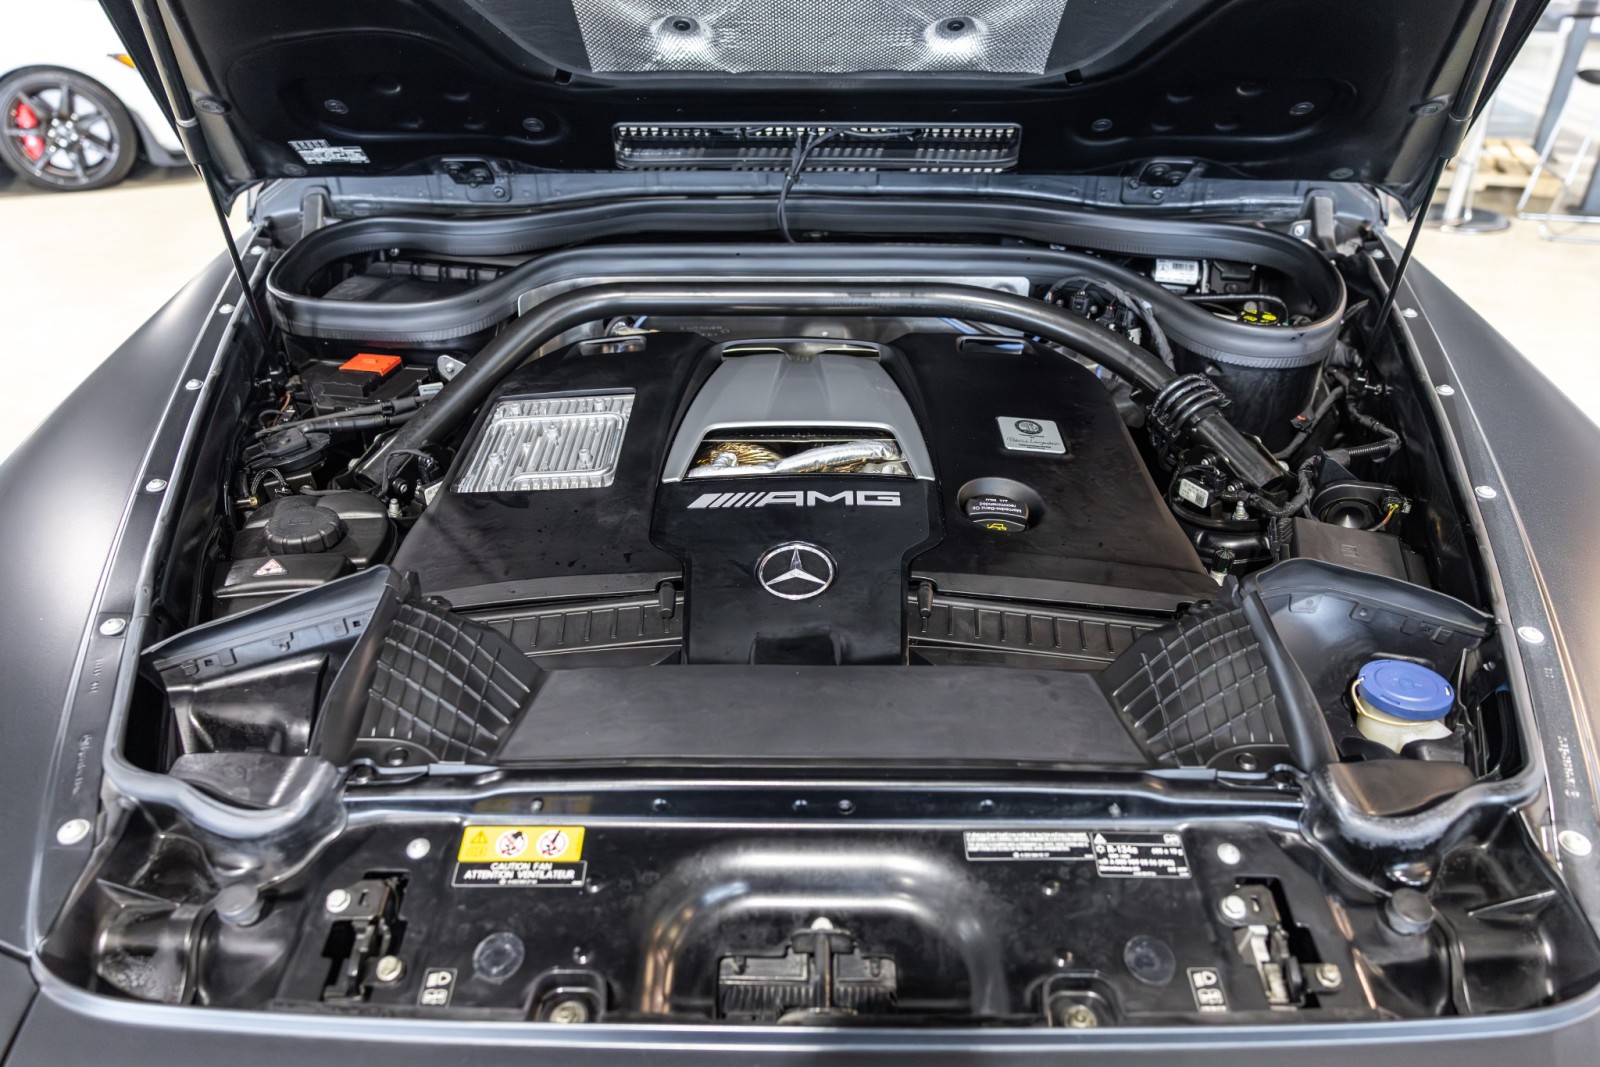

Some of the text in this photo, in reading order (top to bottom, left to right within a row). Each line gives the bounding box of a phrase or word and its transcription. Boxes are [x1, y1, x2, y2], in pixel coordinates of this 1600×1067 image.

[755, 490, 901, 507] AMG
[490, 862, 553, 871] CAUTION FAN
[463, 869, 576, 880] ATTENTION VENTILATEUR
